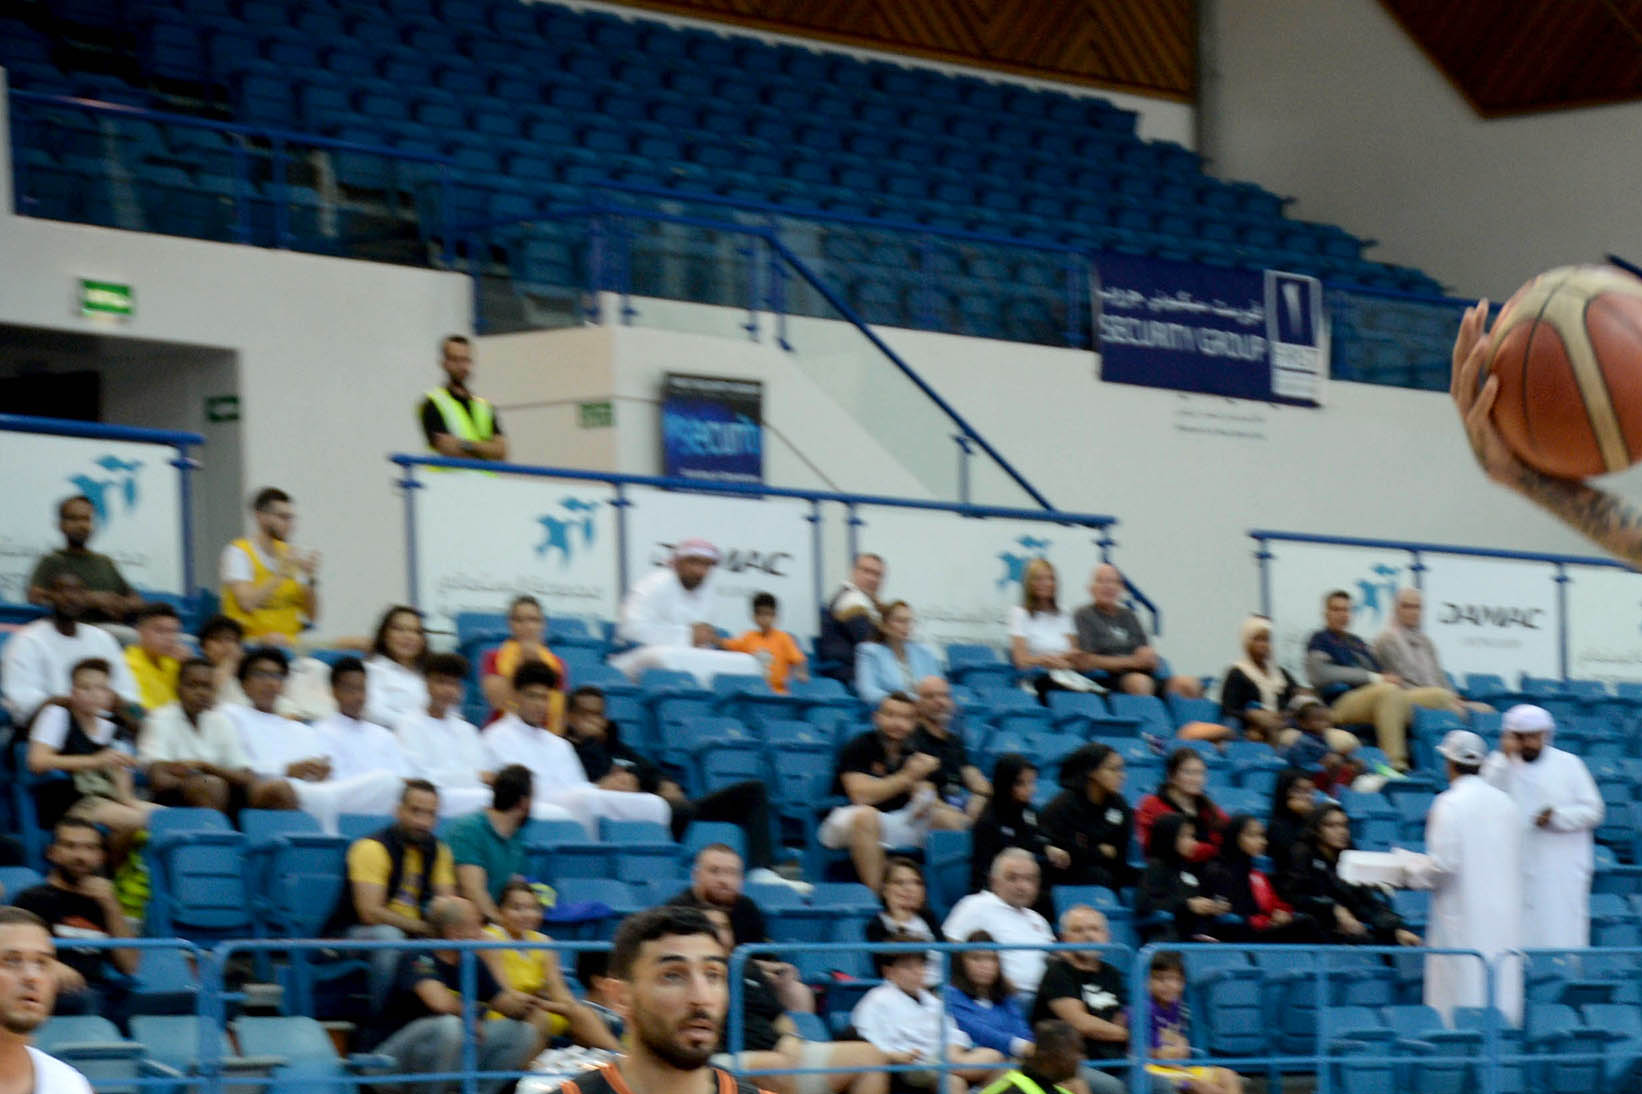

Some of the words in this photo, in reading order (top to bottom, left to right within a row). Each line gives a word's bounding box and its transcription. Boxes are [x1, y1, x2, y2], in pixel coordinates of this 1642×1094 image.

[1098, 312, 1198, 352] SECURITY
[1198, 326, 1268, 363] GROUP
[1438, 602, 1544, 630] DAMAC
